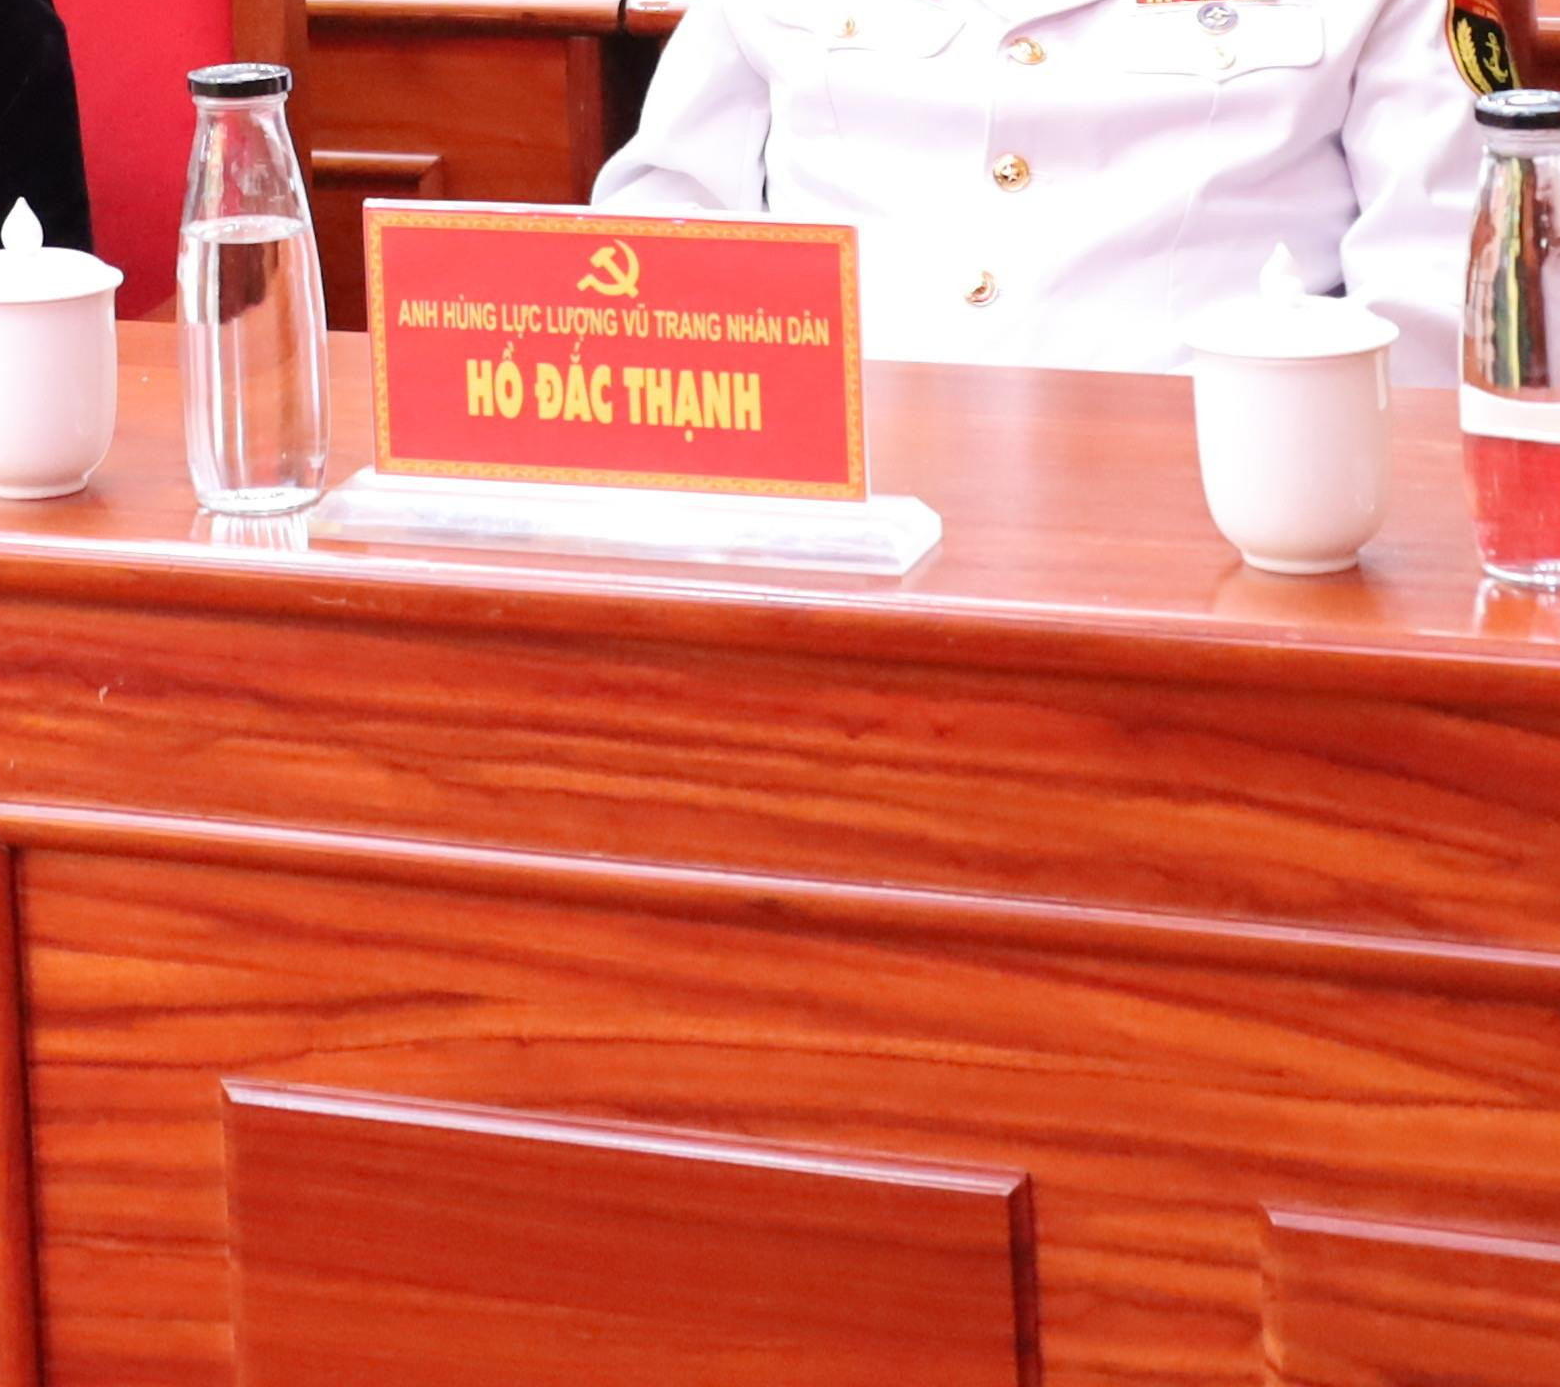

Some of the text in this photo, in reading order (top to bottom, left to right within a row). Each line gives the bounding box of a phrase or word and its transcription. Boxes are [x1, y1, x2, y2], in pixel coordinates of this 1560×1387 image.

[399, 294, 829, 345] ANH HÙNG LỰC LƯỢNG VŨ TRANG NHÂN DÂN
[467, 336, 761, 442] HỒ ĐẮC THẠNH
